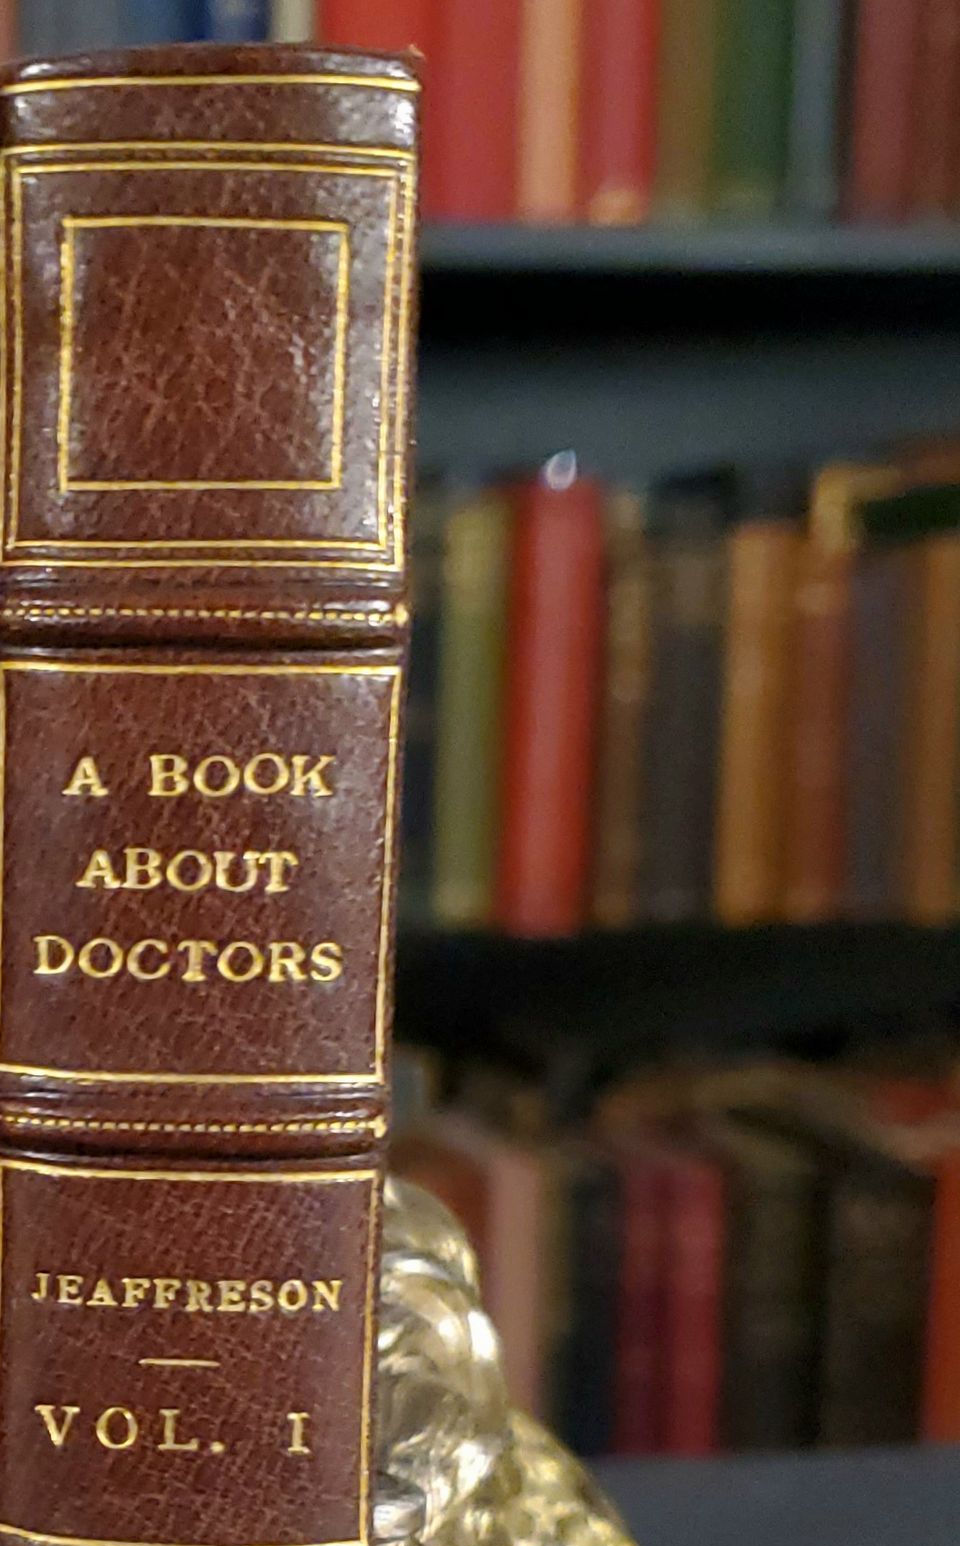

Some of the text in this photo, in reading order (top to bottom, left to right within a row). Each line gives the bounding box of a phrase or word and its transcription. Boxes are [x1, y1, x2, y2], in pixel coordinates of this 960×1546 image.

[62, 753, 336, 797] A BOOK
[76, 847, 299, 894] ABOUT
[33, 935, 343, 983] DOCTORS
[31, 1272, 343, 1313] JEAFFRESON
[34, 1404, 311, 1455] VOL. I
